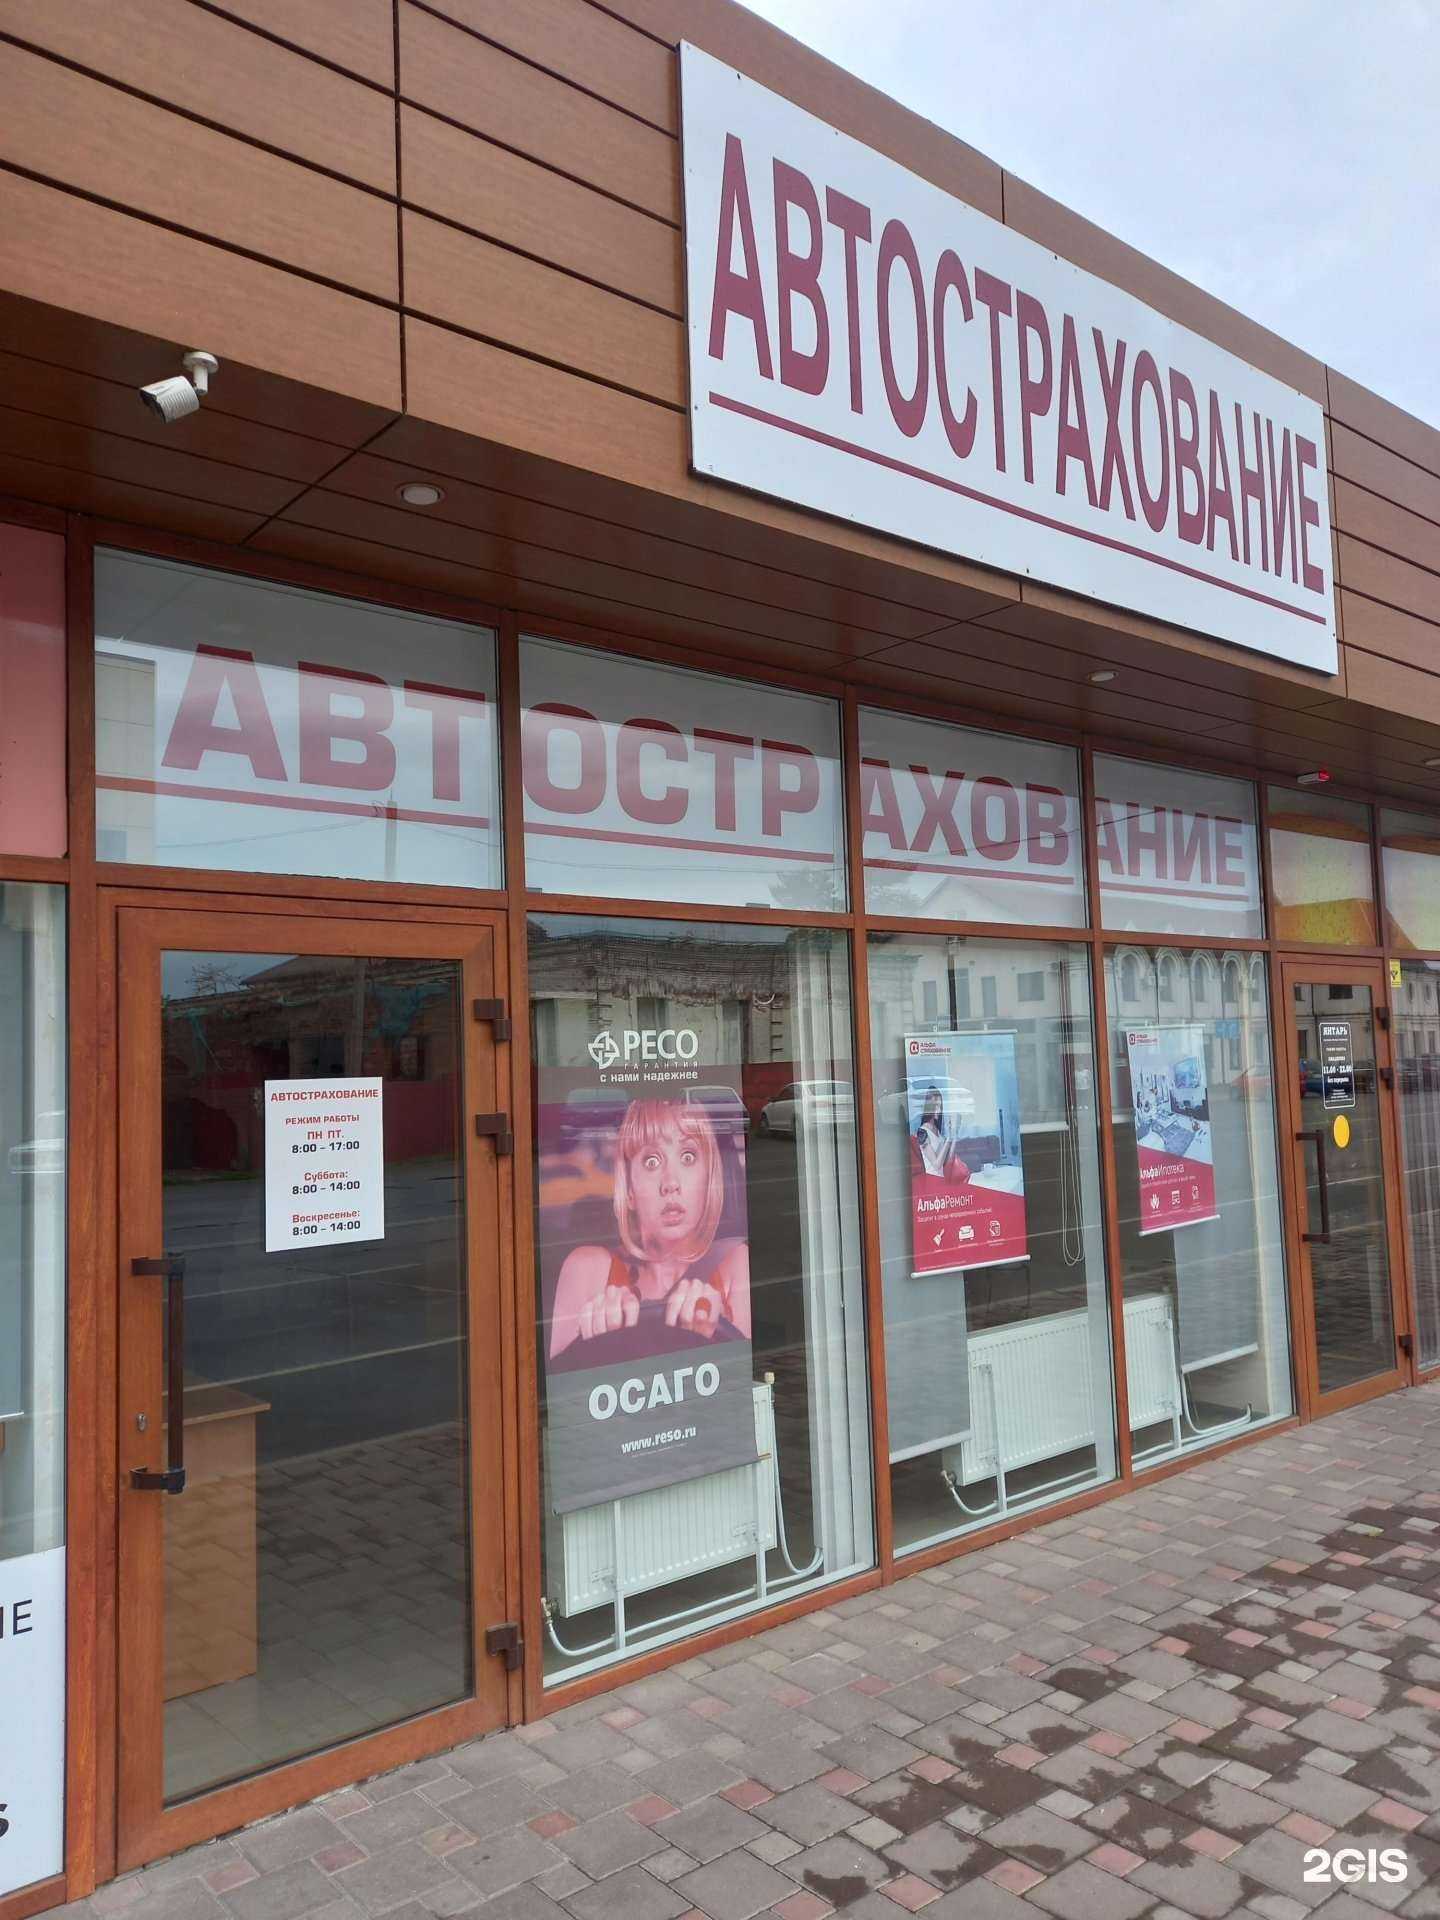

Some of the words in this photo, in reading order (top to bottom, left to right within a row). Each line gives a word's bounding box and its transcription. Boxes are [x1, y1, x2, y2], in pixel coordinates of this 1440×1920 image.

[707, 131, 1325, 595] АВТОСТРАХОВАНИЕ
[623, 1029, 699, 1060] РЕСО
[624, 1061, 698, 1070] ГАРАНТИЯ
[600, 1073, 606, 1083] с
[610, 1072, 640, 1083] нами
[643, 1071, 698, 1082] надежнее
[271, 1089, 379, 1102] АВТОСТРАХОВАНИЕ
[285, 1116, 321, 1125] РЕЖИМ
[324, 1114, 360, 1123] РАБОТЫ
[307, 1131, 323, 1140] ПН
[328, 1129, 345, 1139] ПТ.
[292, 1143, 317, 1153] 8:00
[329, 1141, 360, 1151] 17:00
[304, 1171, 348, 1182] Суббота:
[292, 1184, 317, 1195] 8:00
[330, 1181, 360, 1191] 14:00
[917, 1195, 974, 1212] АльфаРемонт
[292, 1210, 360, 1223] Воскресенье:
[292, 1225, 318, 1236] 8:00
[330, 1221, 361, 1232] 14:00
[588, 1362, 720, 1421] ОСАГО
[621, 1426, 697, 1454] www.reso.ru
